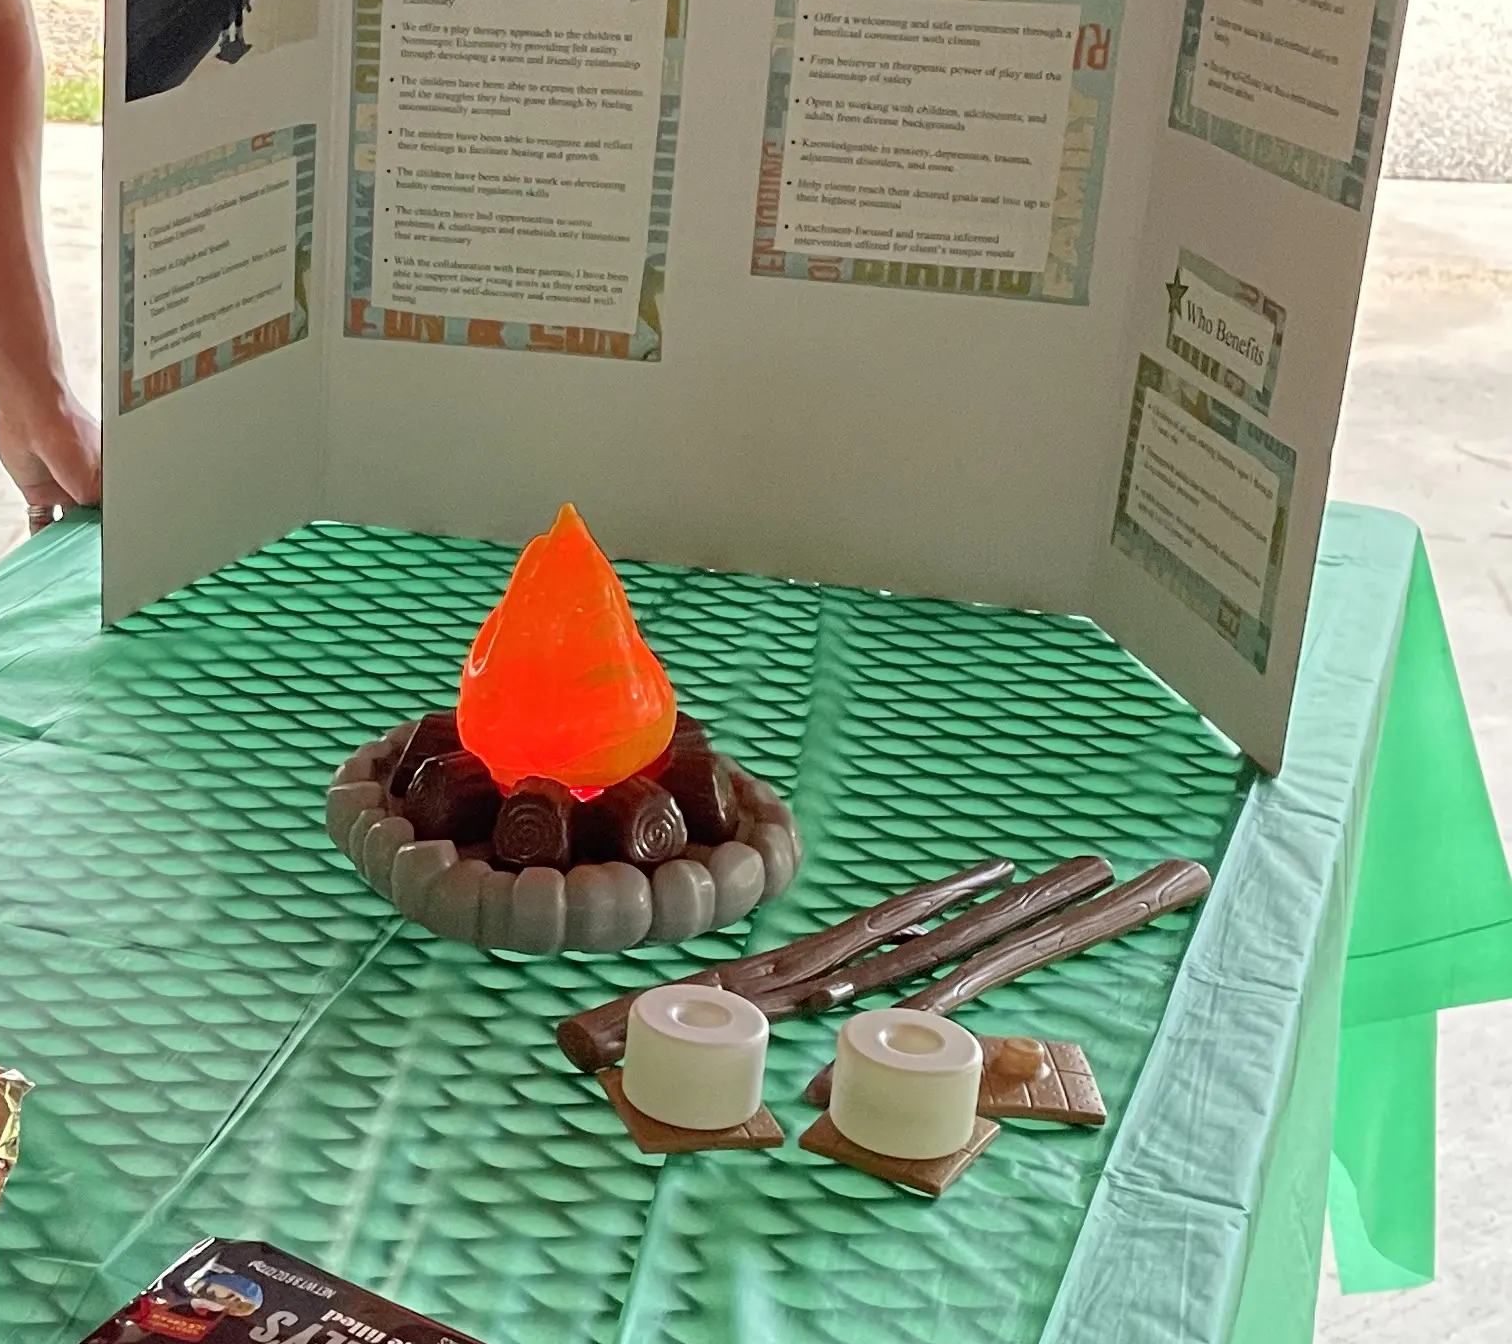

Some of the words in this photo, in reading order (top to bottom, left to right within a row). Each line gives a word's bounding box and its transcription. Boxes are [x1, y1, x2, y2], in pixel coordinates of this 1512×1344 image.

[1186, 301, 1215, 335] Who
[1215, 320, 1266, 367] Benefits
[320, 1309, 387, 1344] filled
